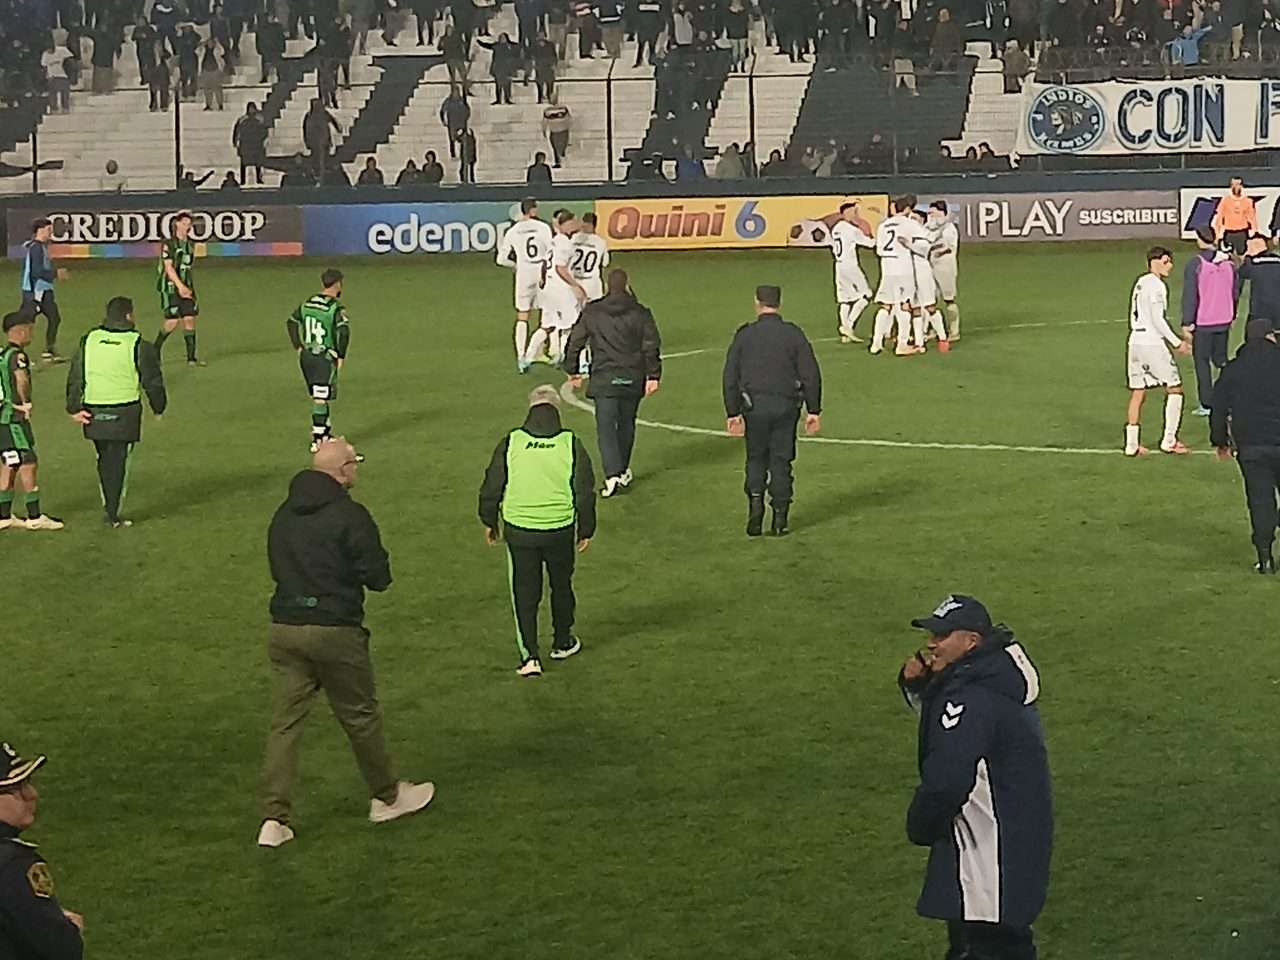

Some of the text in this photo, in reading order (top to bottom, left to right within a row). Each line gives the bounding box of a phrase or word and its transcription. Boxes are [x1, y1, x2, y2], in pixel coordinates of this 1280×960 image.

[1117, 83, 1227, 148] CON
[368, 213, 512, 254] edenor
[607, 201, 767, 240] Quini 6
[979, 200, 1073, 237] PLAY
[1079, 208, 1178, 226] SUSCRIBITE
[526, 236, 538, 258] 6
[883, 229, 896, 251] 2
[571, 248, 598, 272] 20
[305, 315, 326, 345] 14
